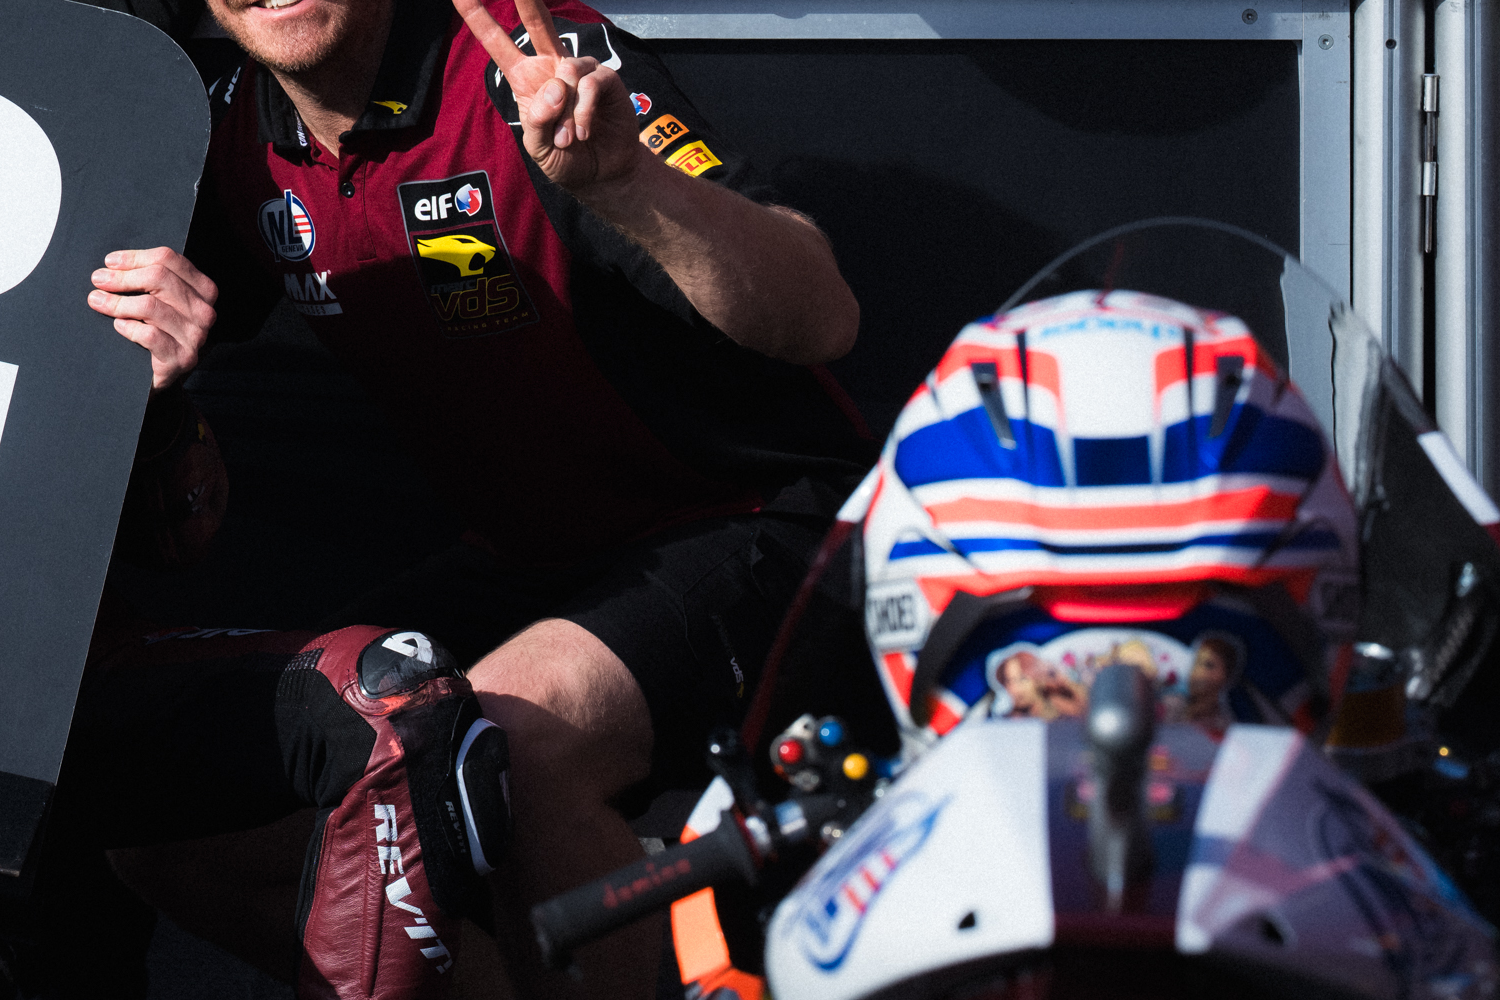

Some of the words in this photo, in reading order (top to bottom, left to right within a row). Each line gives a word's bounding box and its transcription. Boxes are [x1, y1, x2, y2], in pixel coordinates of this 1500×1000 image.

[648, 121, 684, 149] eta
[414, 192, 453, 221] elf
[267, 190, 307, 260] NL
[281, 244, 304, 253] GENEVA
[495, 311, 529, 325] TEAM
